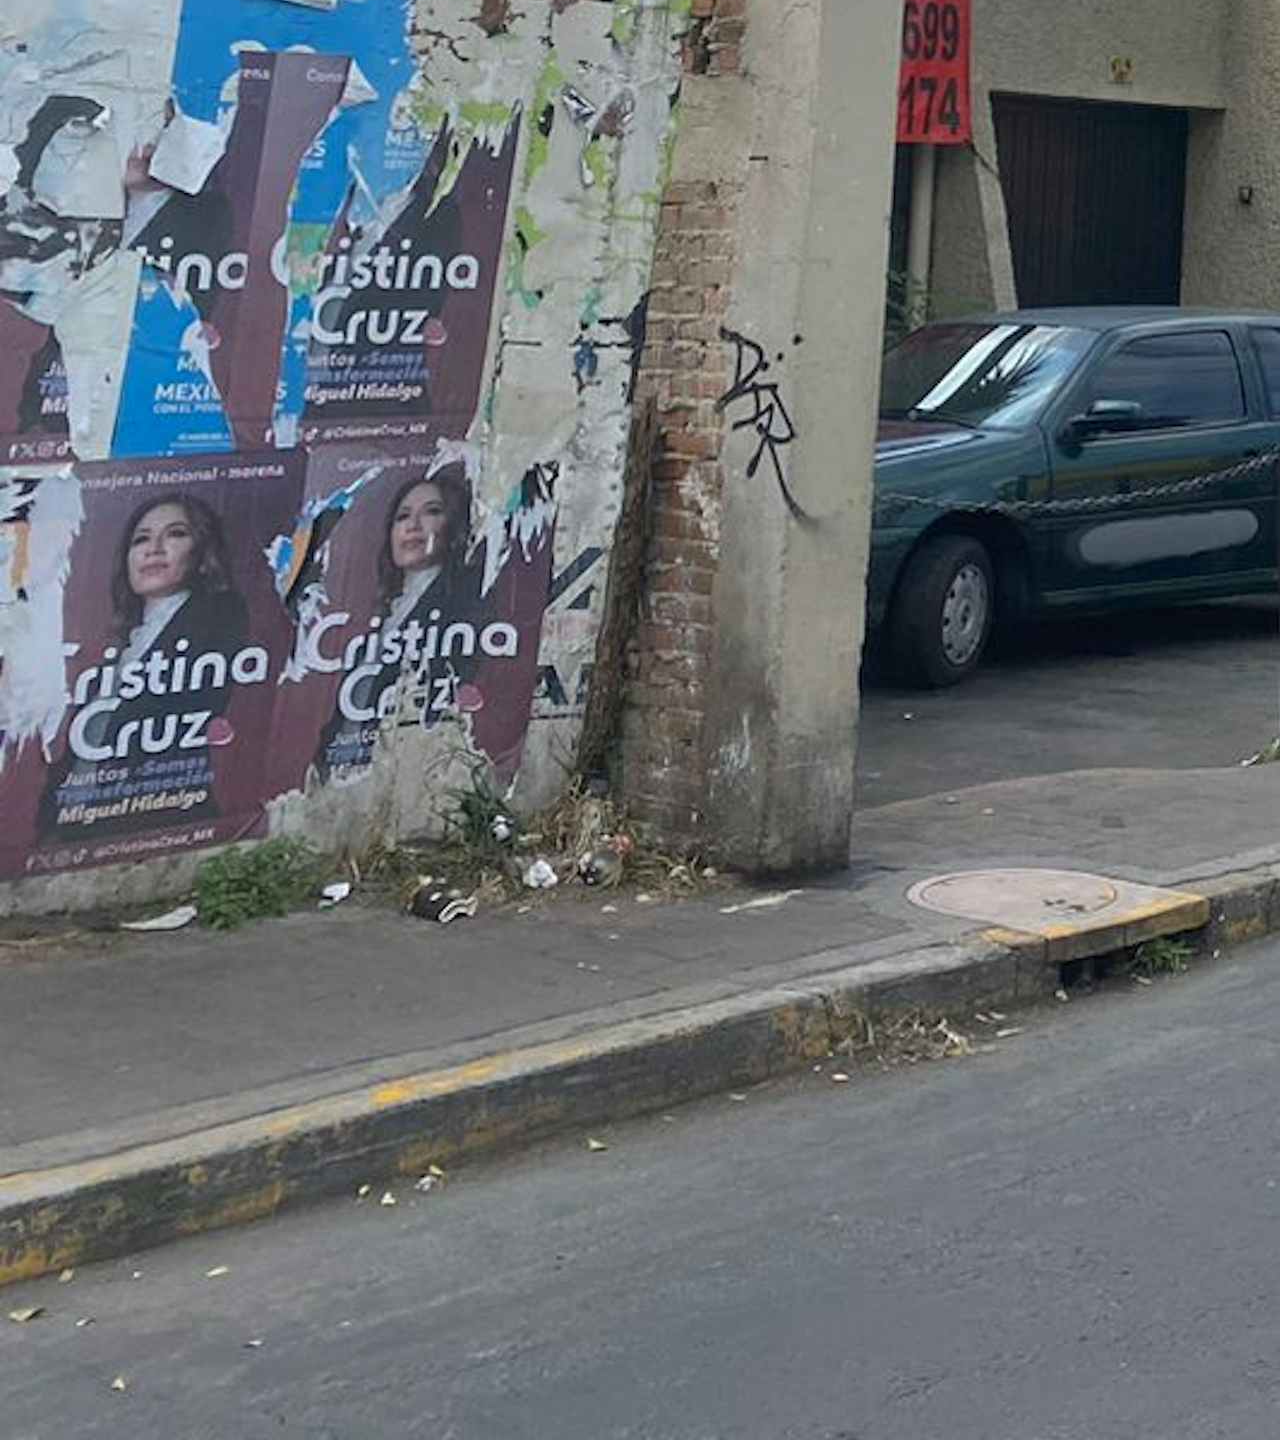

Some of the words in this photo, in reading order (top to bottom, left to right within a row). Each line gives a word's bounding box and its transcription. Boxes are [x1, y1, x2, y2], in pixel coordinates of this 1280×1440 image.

[310, 286, 430, 345] Cruz
[356, 383, 423, 403] Hidalgo
[308, 608, 518, 674] Cristina
[63, 638, 269, 705] ristina
[339, 662, 460, 722] Crz
[69, 697, 213, 762] Cruz
[57, 799, 130, 825] Miguel
[130, 789, 208, 814] Hidalgo
